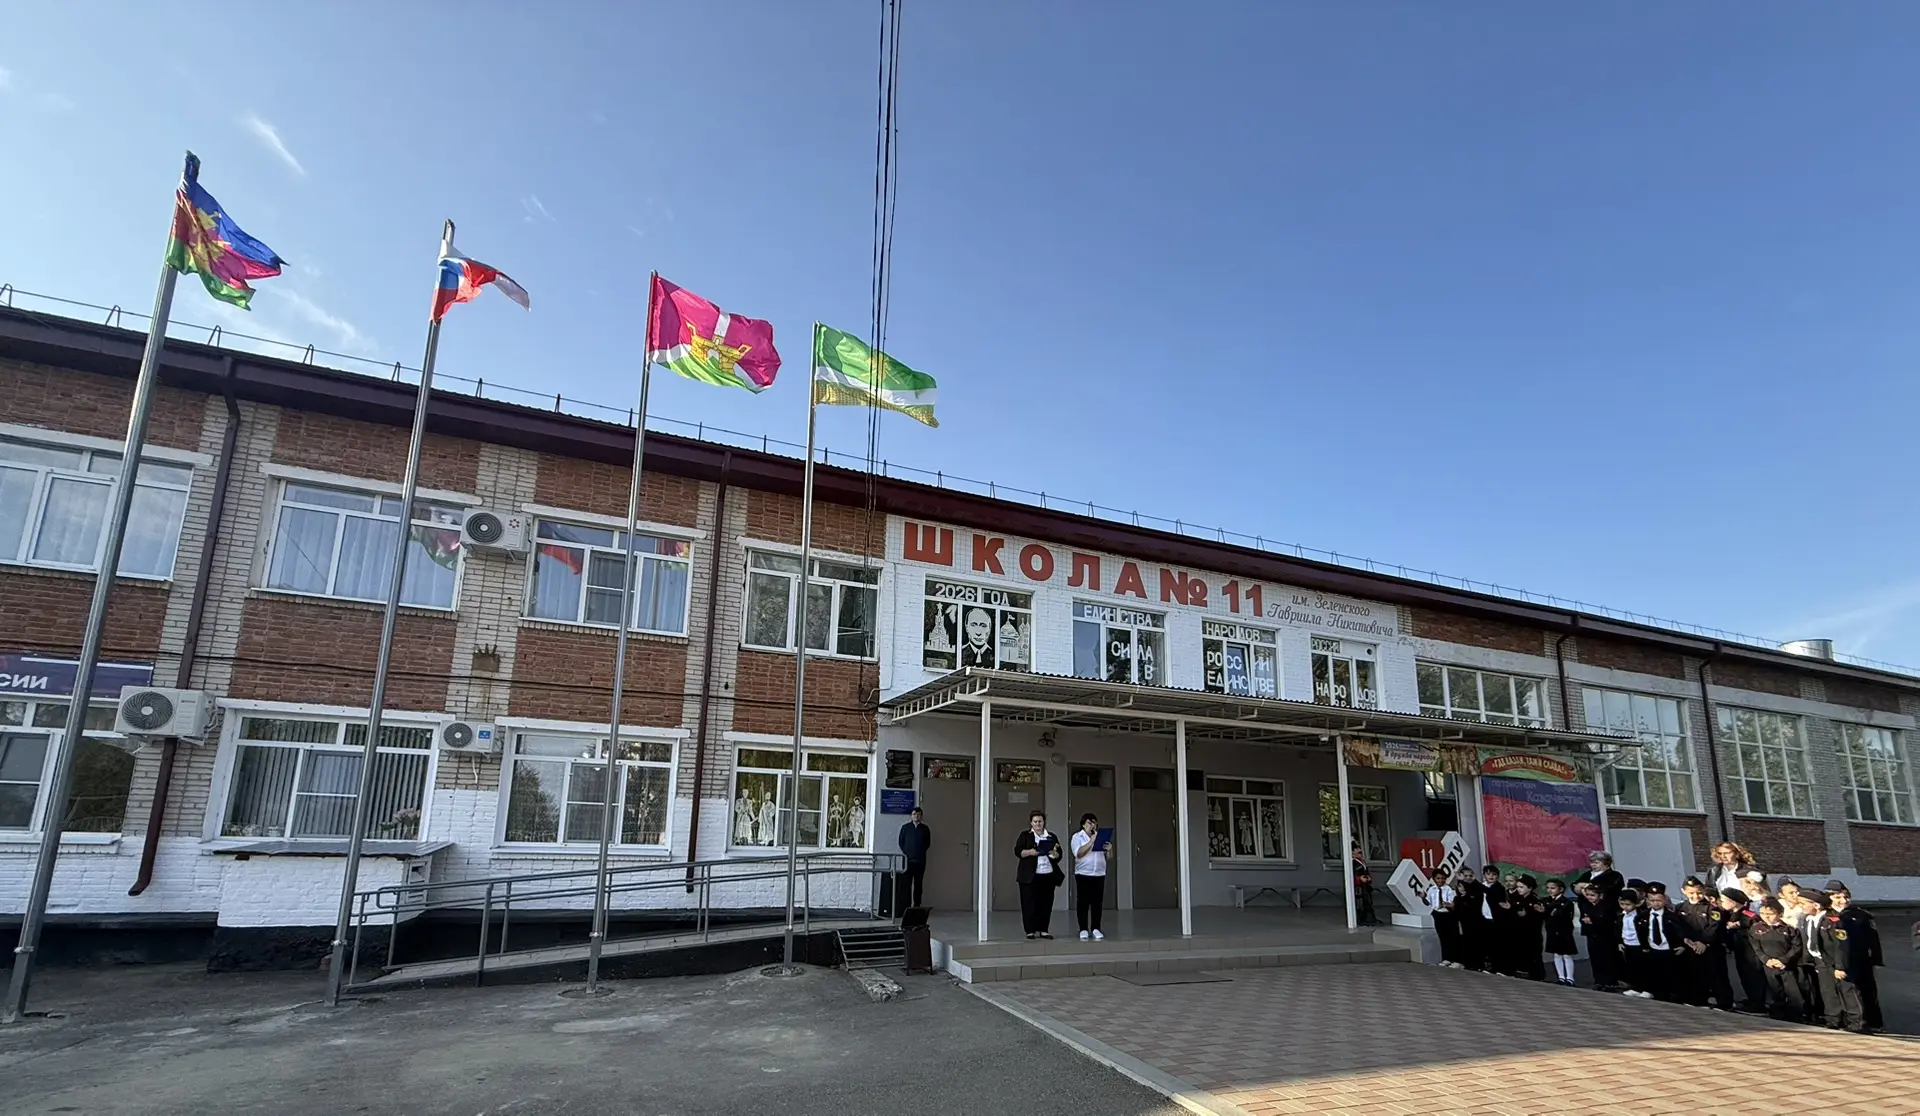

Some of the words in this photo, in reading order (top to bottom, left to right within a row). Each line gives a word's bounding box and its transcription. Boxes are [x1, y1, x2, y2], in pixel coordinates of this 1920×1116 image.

[904, 521, 1147, 599] ШКОЛА
[1160, 569, 1208, 608] №
[1222, 580, 1263, 617] 11
[935, 583, 976, 601] 2026
[981, 589, 1010, 607] ГОД
[1291, 594, 1310, 607] им.
[1314, 594, 1371, 617] Зеленского
[1084, 604, 1152, 627] ЕДИНСТВА
[1267, 603, 1322, 626] Гавриила
[1327, 612, 1394, 637] Никитовича
[1205, 623, 1261, 642] НАРОДОВ
[1111, 640, 1154, 662] СИЛА
[1312, 637, 1340, 653] РОССИИ
[1207, 651, 1270, 672] РОССИИ
[1144, 664, 1154, 681] В
[1316, 682, 1376, 703] НАРОДОВ
[1421, 848, 1434, 869] 11
